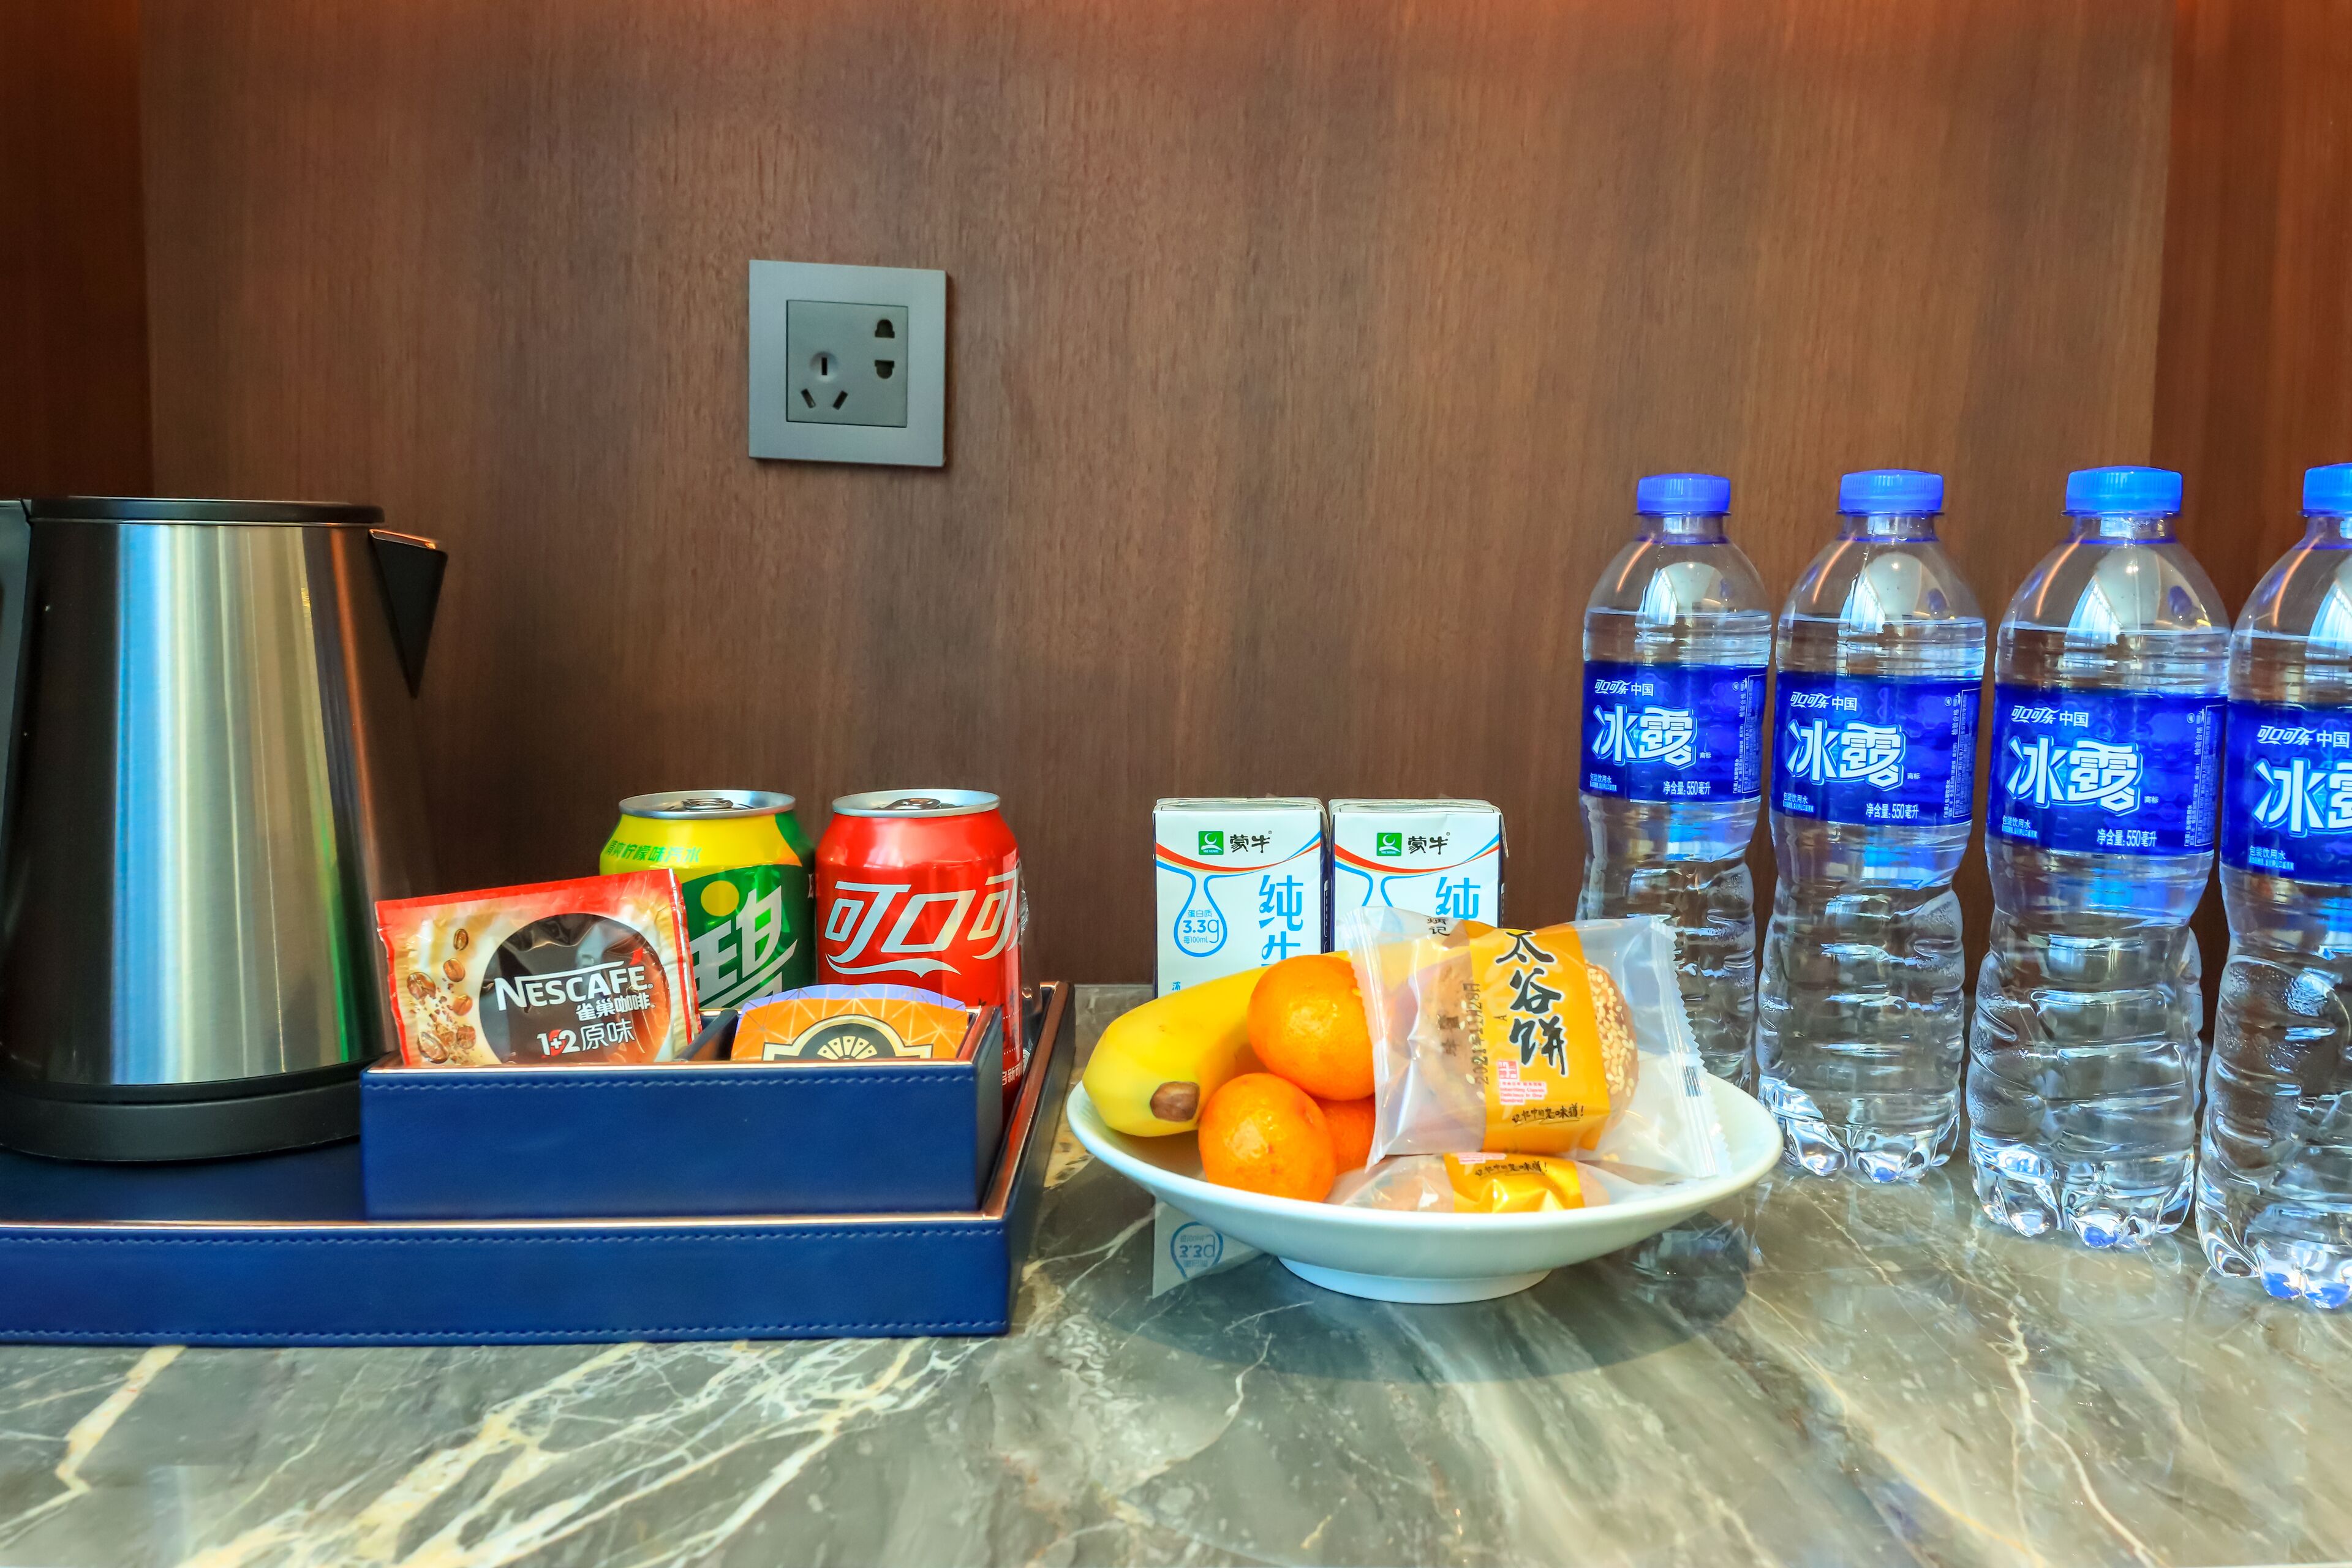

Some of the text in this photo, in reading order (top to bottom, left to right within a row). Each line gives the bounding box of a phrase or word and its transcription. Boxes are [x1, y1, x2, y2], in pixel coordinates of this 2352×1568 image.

[1592, 703, 1697, 769] 冰露
[1785, 718, 1905, 790] 冰露
[2005, 735, 2141, 817] 冰露
[1229, 834, 1271, 854] 蒙牛
[1408, 835, 1449, 855] 蒙牛
[824, 869, 1019, 964] 可口可
[1183, 919, 1219, 944] 3.3g
[1188, 909, 1213, 918] 蛋白质
[1259, 875, 1303, 967] 纯牛
[575, 992, 651, 1022] 雀巢咖啡
[1495, 930, 1566, 1076] 太谷饼
